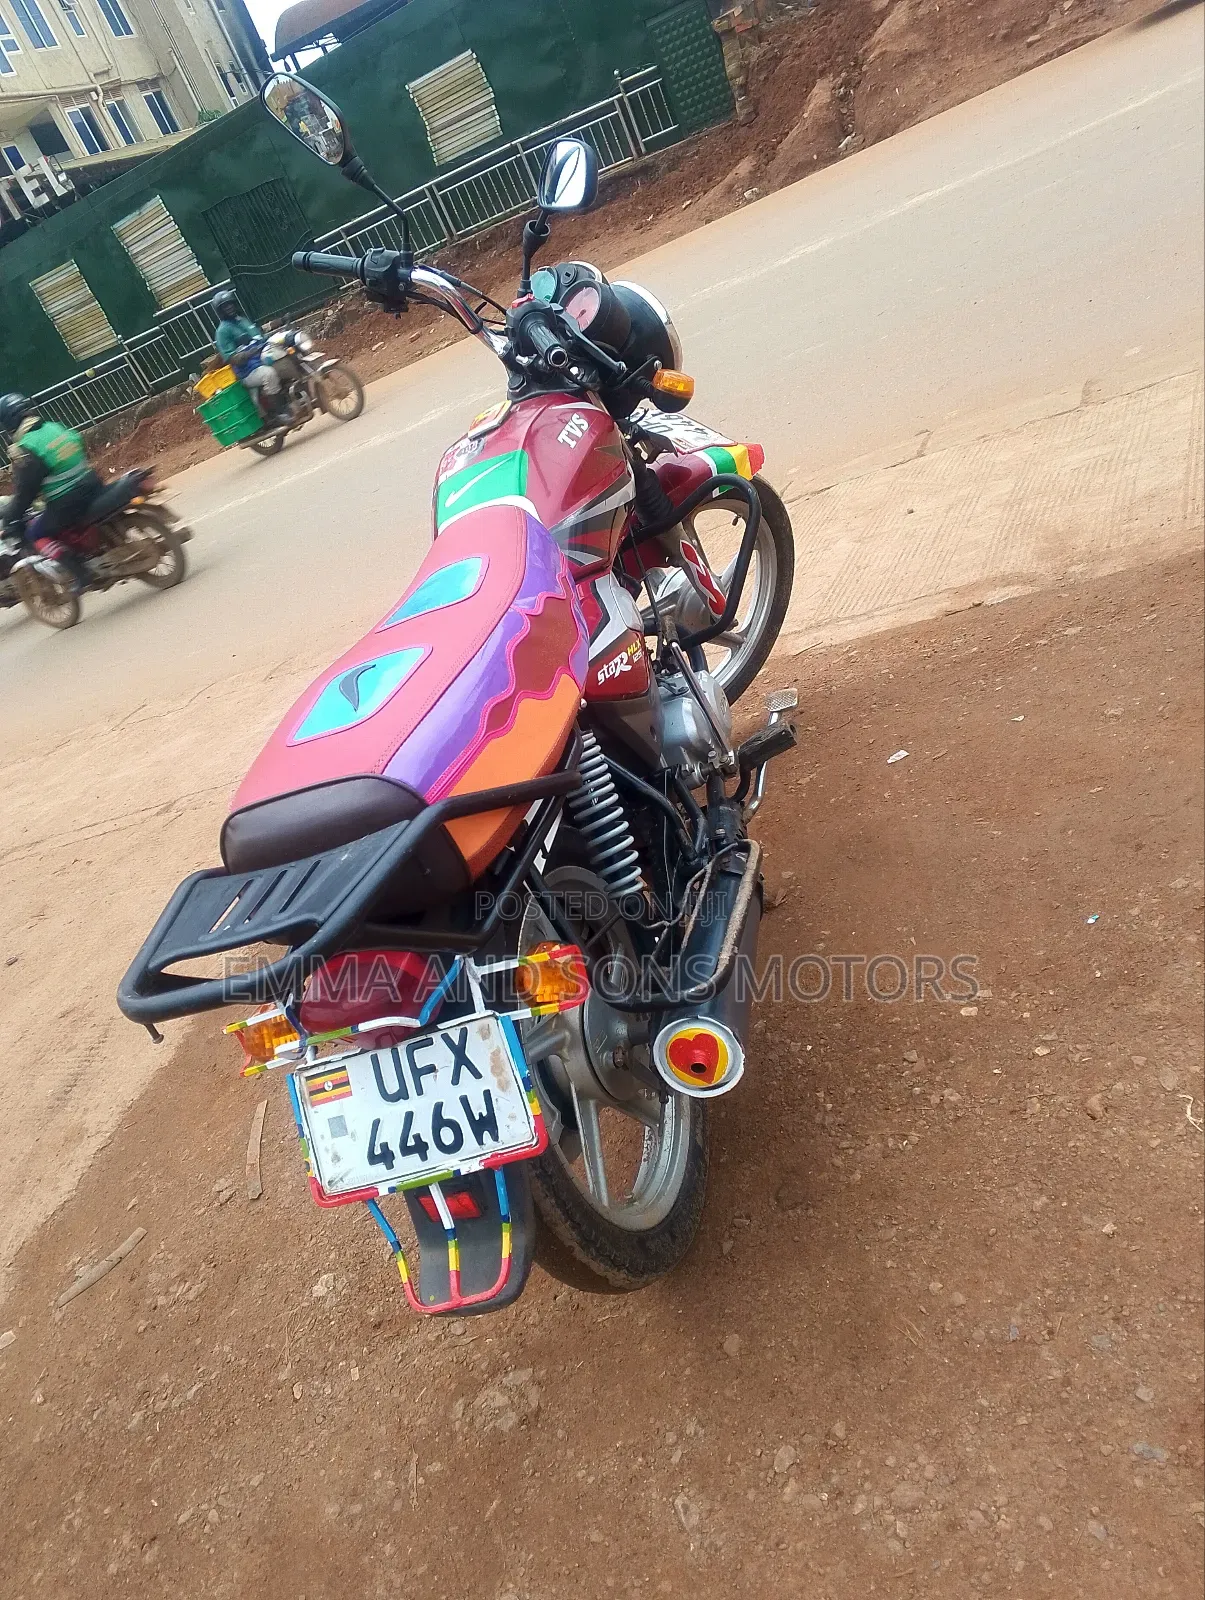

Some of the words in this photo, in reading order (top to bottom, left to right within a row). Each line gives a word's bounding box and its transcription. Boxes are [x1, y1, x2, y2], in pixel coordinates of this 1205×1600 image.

[0, 156, 68, 221] TEL
[557, 413, 589, 449] TVS
[370, 1027, 482, 1103] UFX
[367, 1089, 499, 1170] 446W
